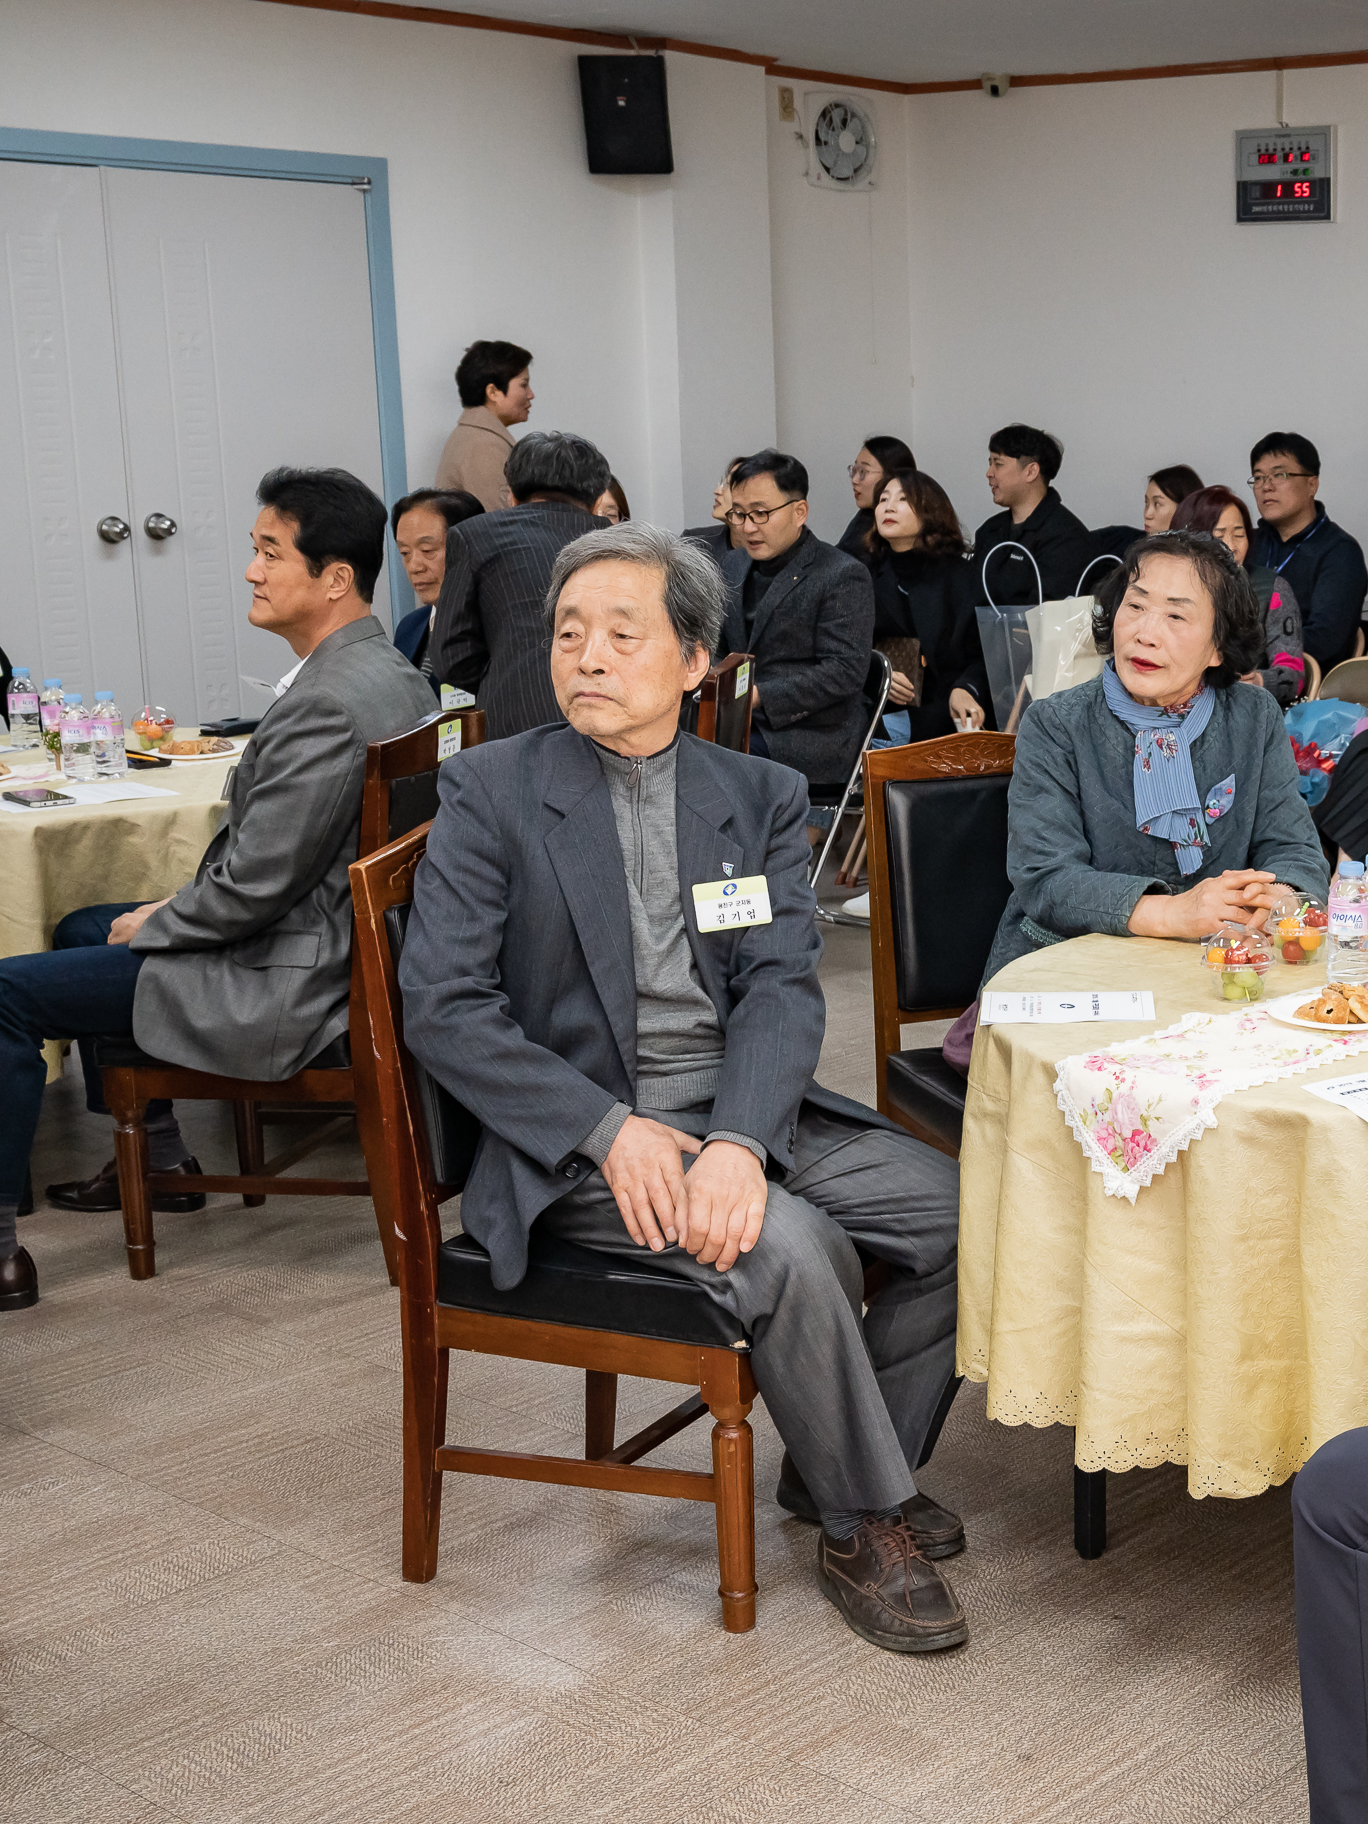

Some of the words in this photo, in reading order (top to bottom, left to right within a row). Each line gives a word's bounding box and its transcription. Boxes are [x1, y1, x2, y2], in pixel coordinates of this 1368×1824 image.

[1276, 184, 1282, 198] 1
[1294, 182, 1310, 198] 55
[1332, 912, 1363, 923] 아이시스
